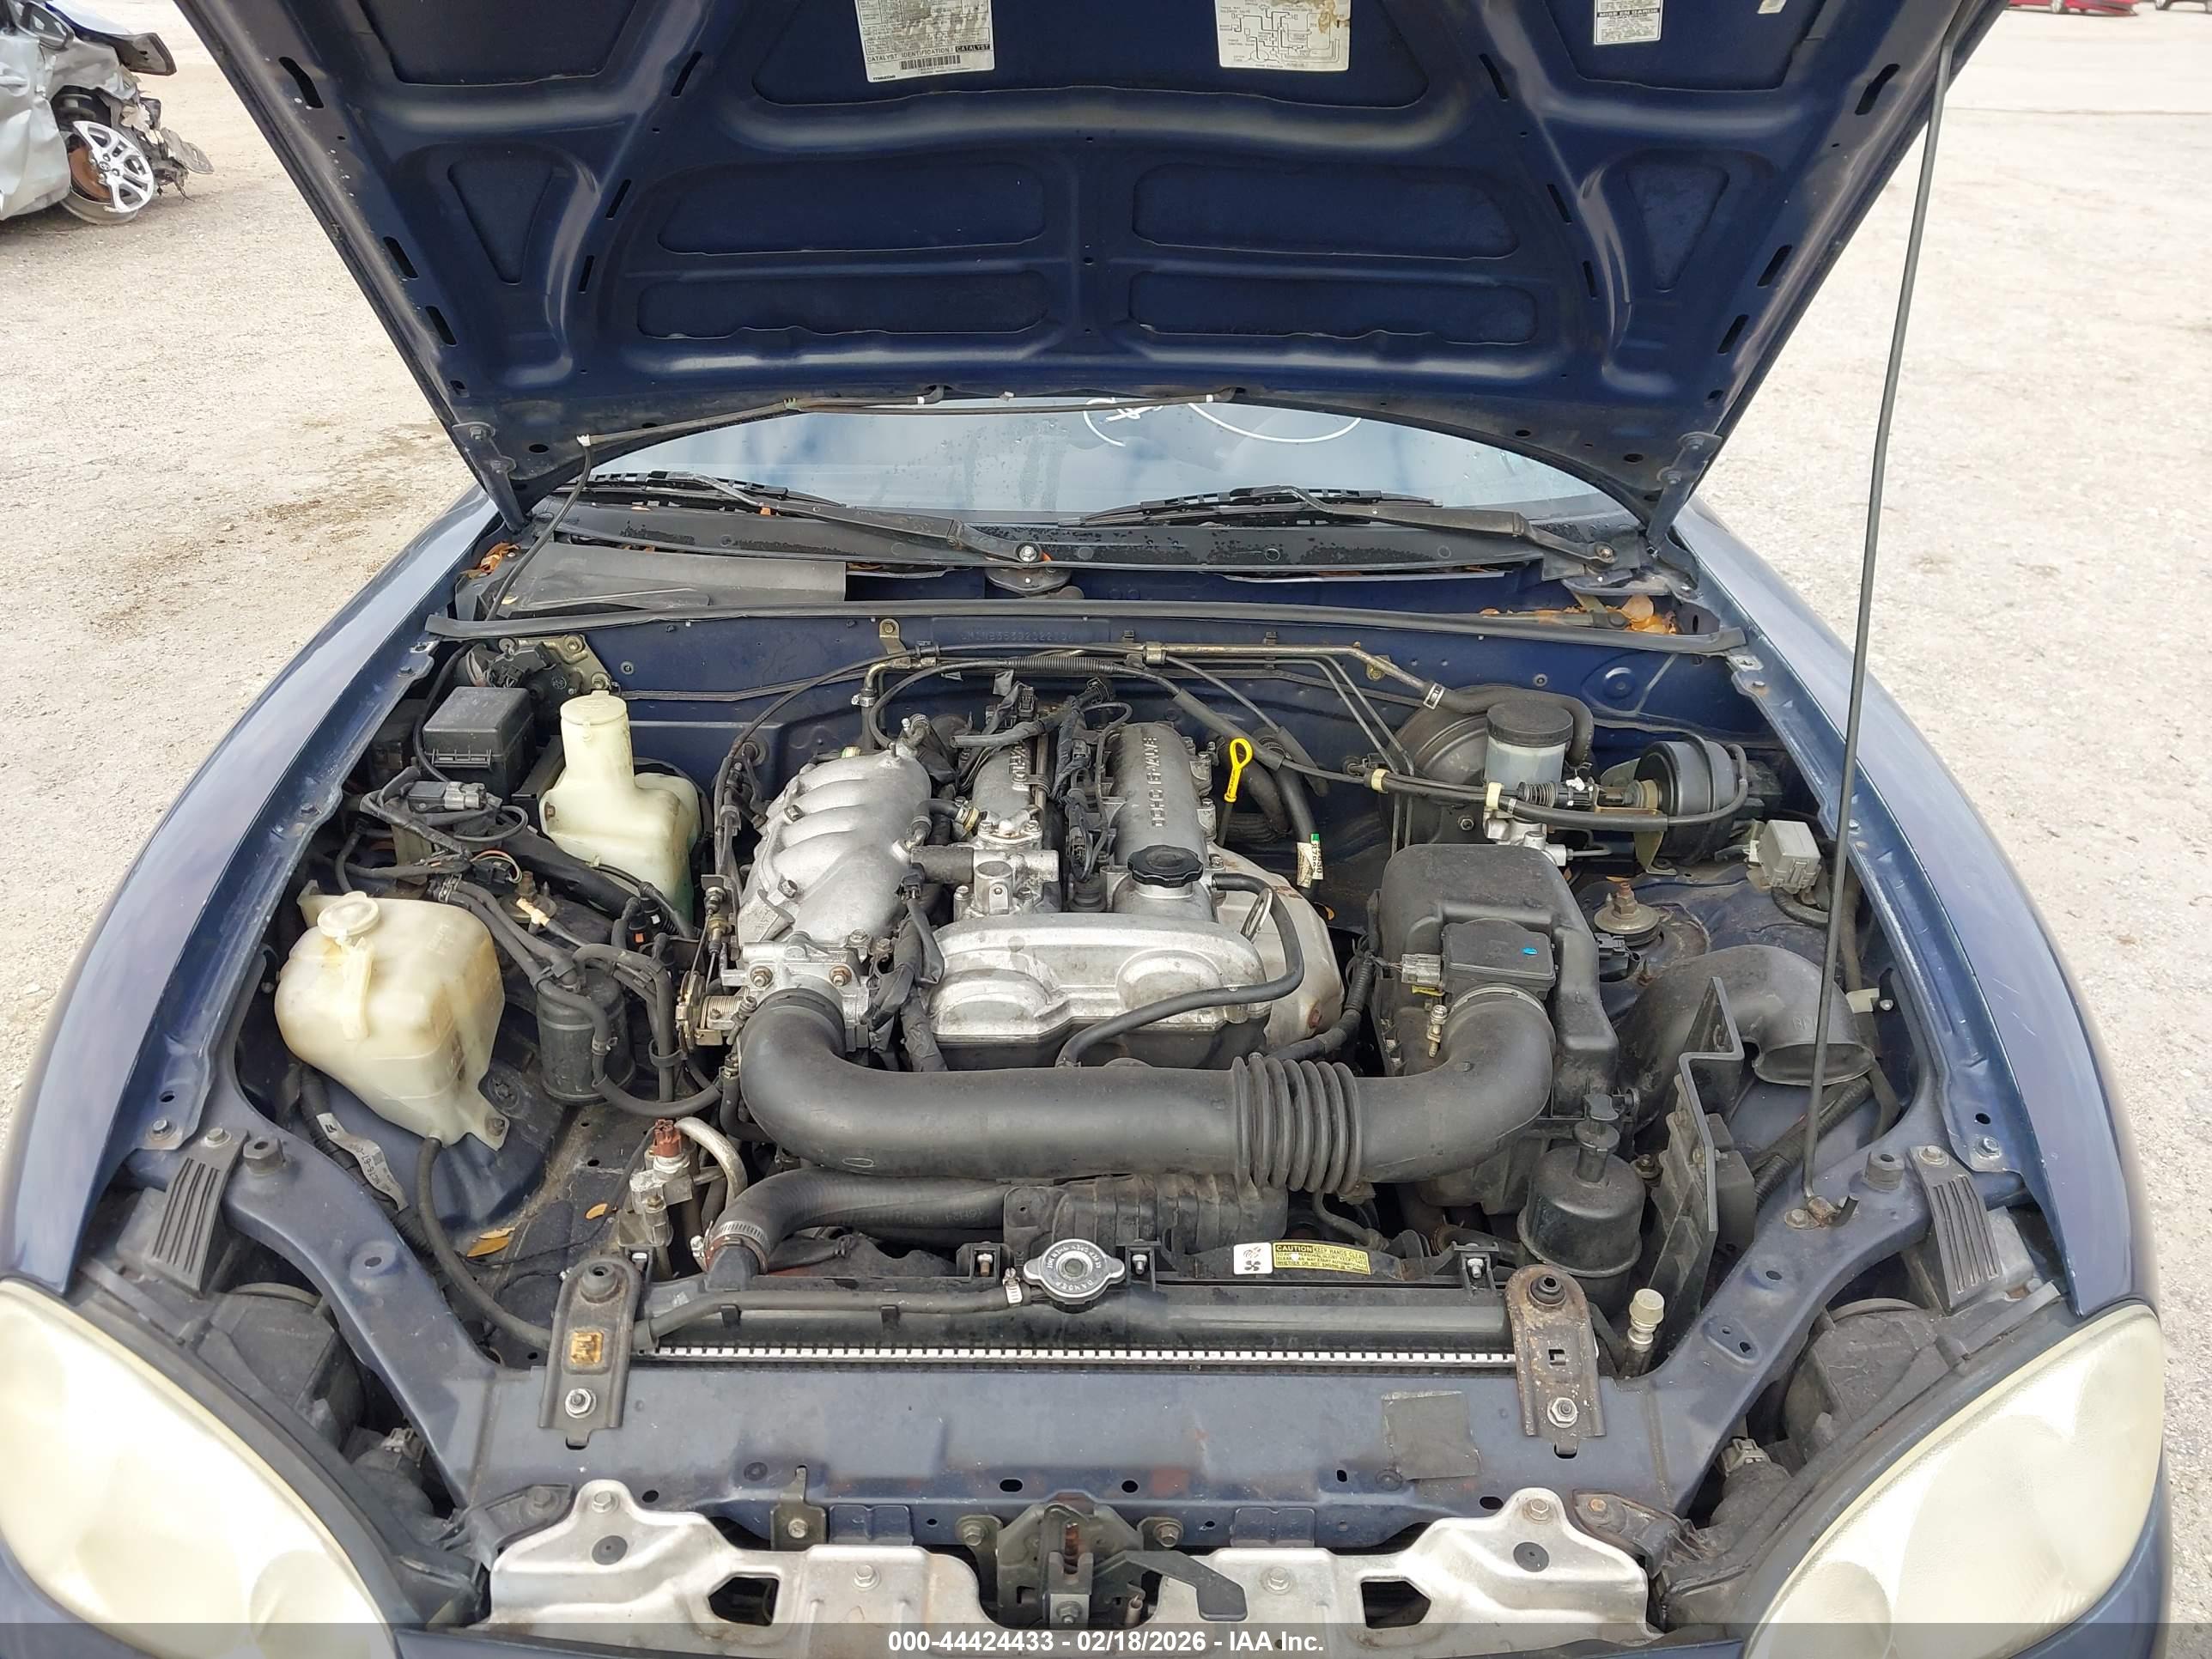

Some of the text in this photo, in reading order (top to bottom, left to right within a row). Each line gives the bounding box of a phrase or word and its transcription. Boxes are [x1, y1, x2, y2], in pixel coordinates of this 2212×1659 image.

[867, 52, 897, 63] CATALYST
[902, 47, 949, 58] IDENTIFICATION
[1329, 1249, 1347, 1258] HANDS
[1348, 1250, 1366, 1260] CLEAR
[1055, 1279, 1094, 1291] DANGER
